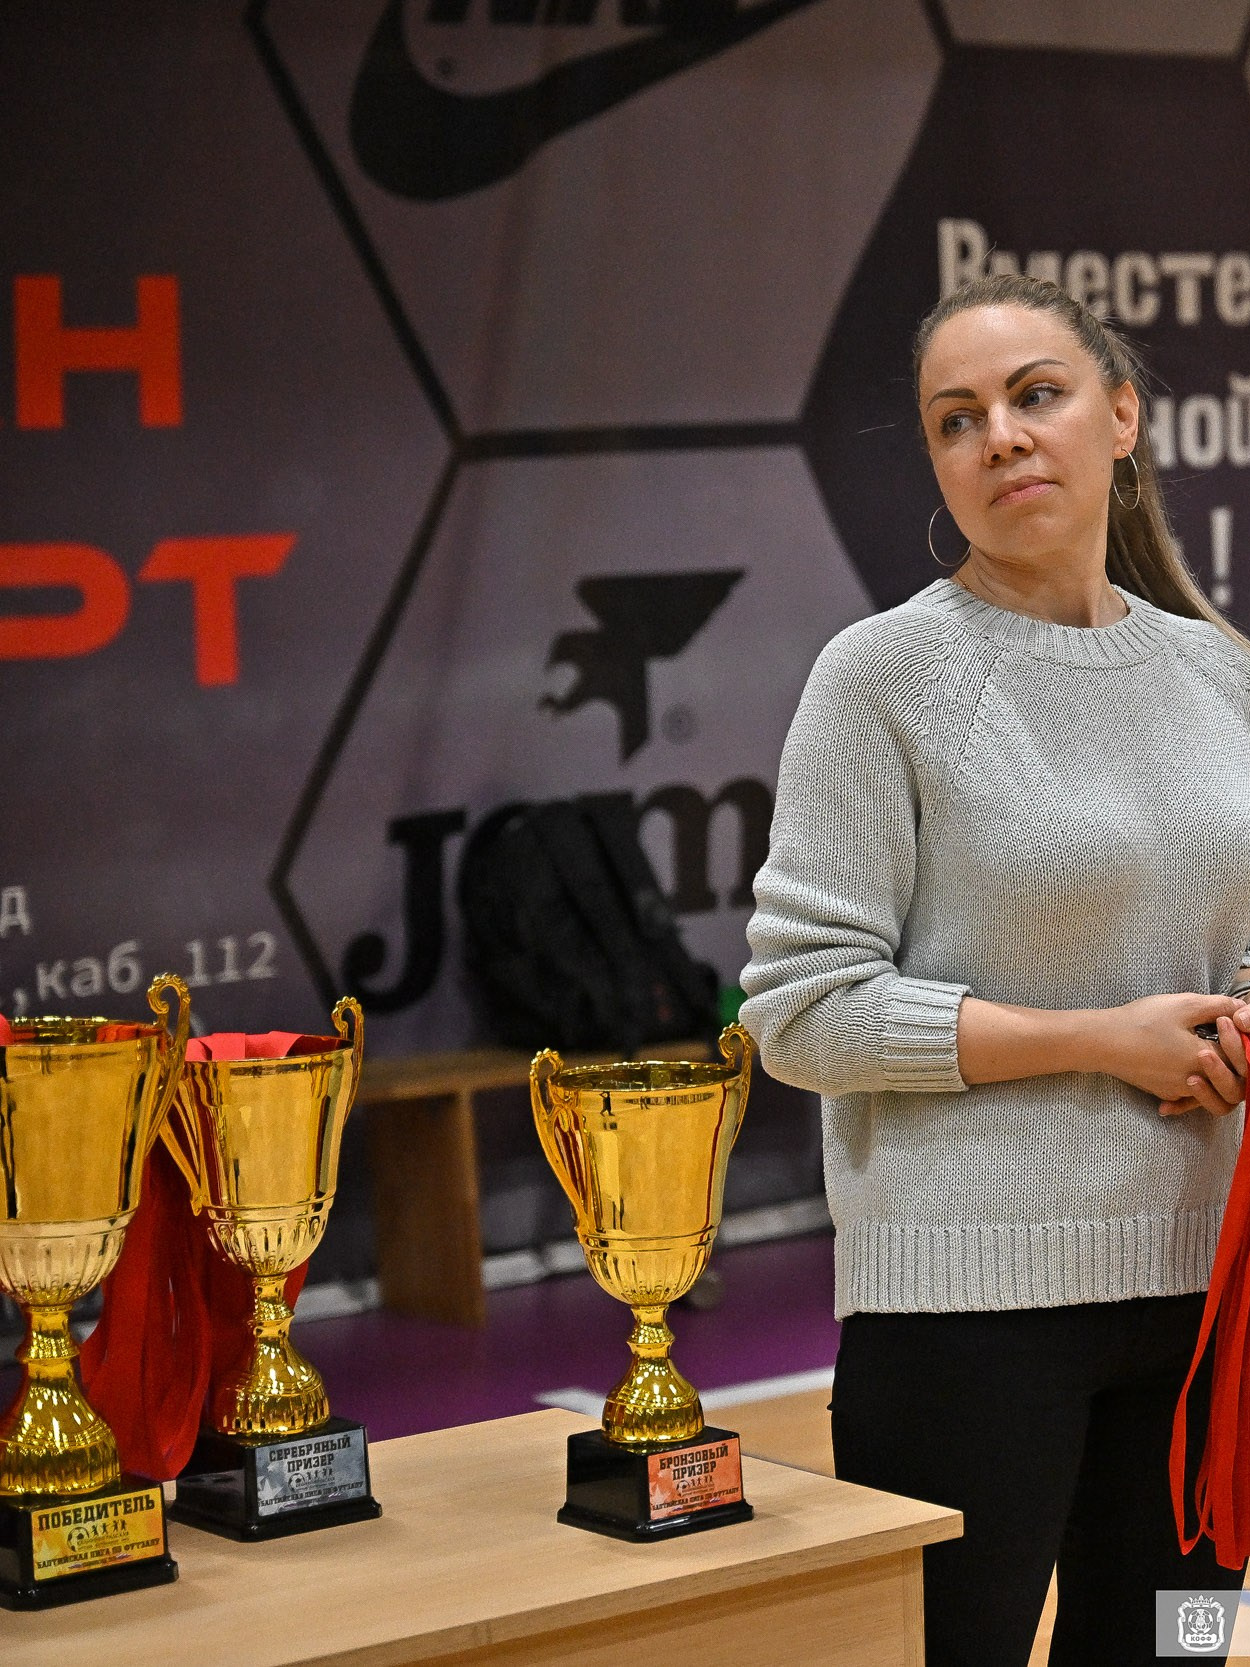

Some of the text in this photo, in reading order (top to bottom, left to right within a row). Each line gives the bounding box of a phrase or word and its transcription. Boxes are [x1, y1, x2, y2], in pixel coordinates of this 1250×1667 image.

[185, 931, 279, 987] 112
[269, 1434, 351, 1462] СЕРЕБРЯНЫЙ
[659, 1443, 729, 1471] БРОНЗОВЫЙ
[287, 1453, 335, 1473] ПРИЗЕР
[672, 1461, 717, 1480] ПРИЗЕР
[38, 1494, 155, 1531] ПОБЕДИТЕЛЬ
